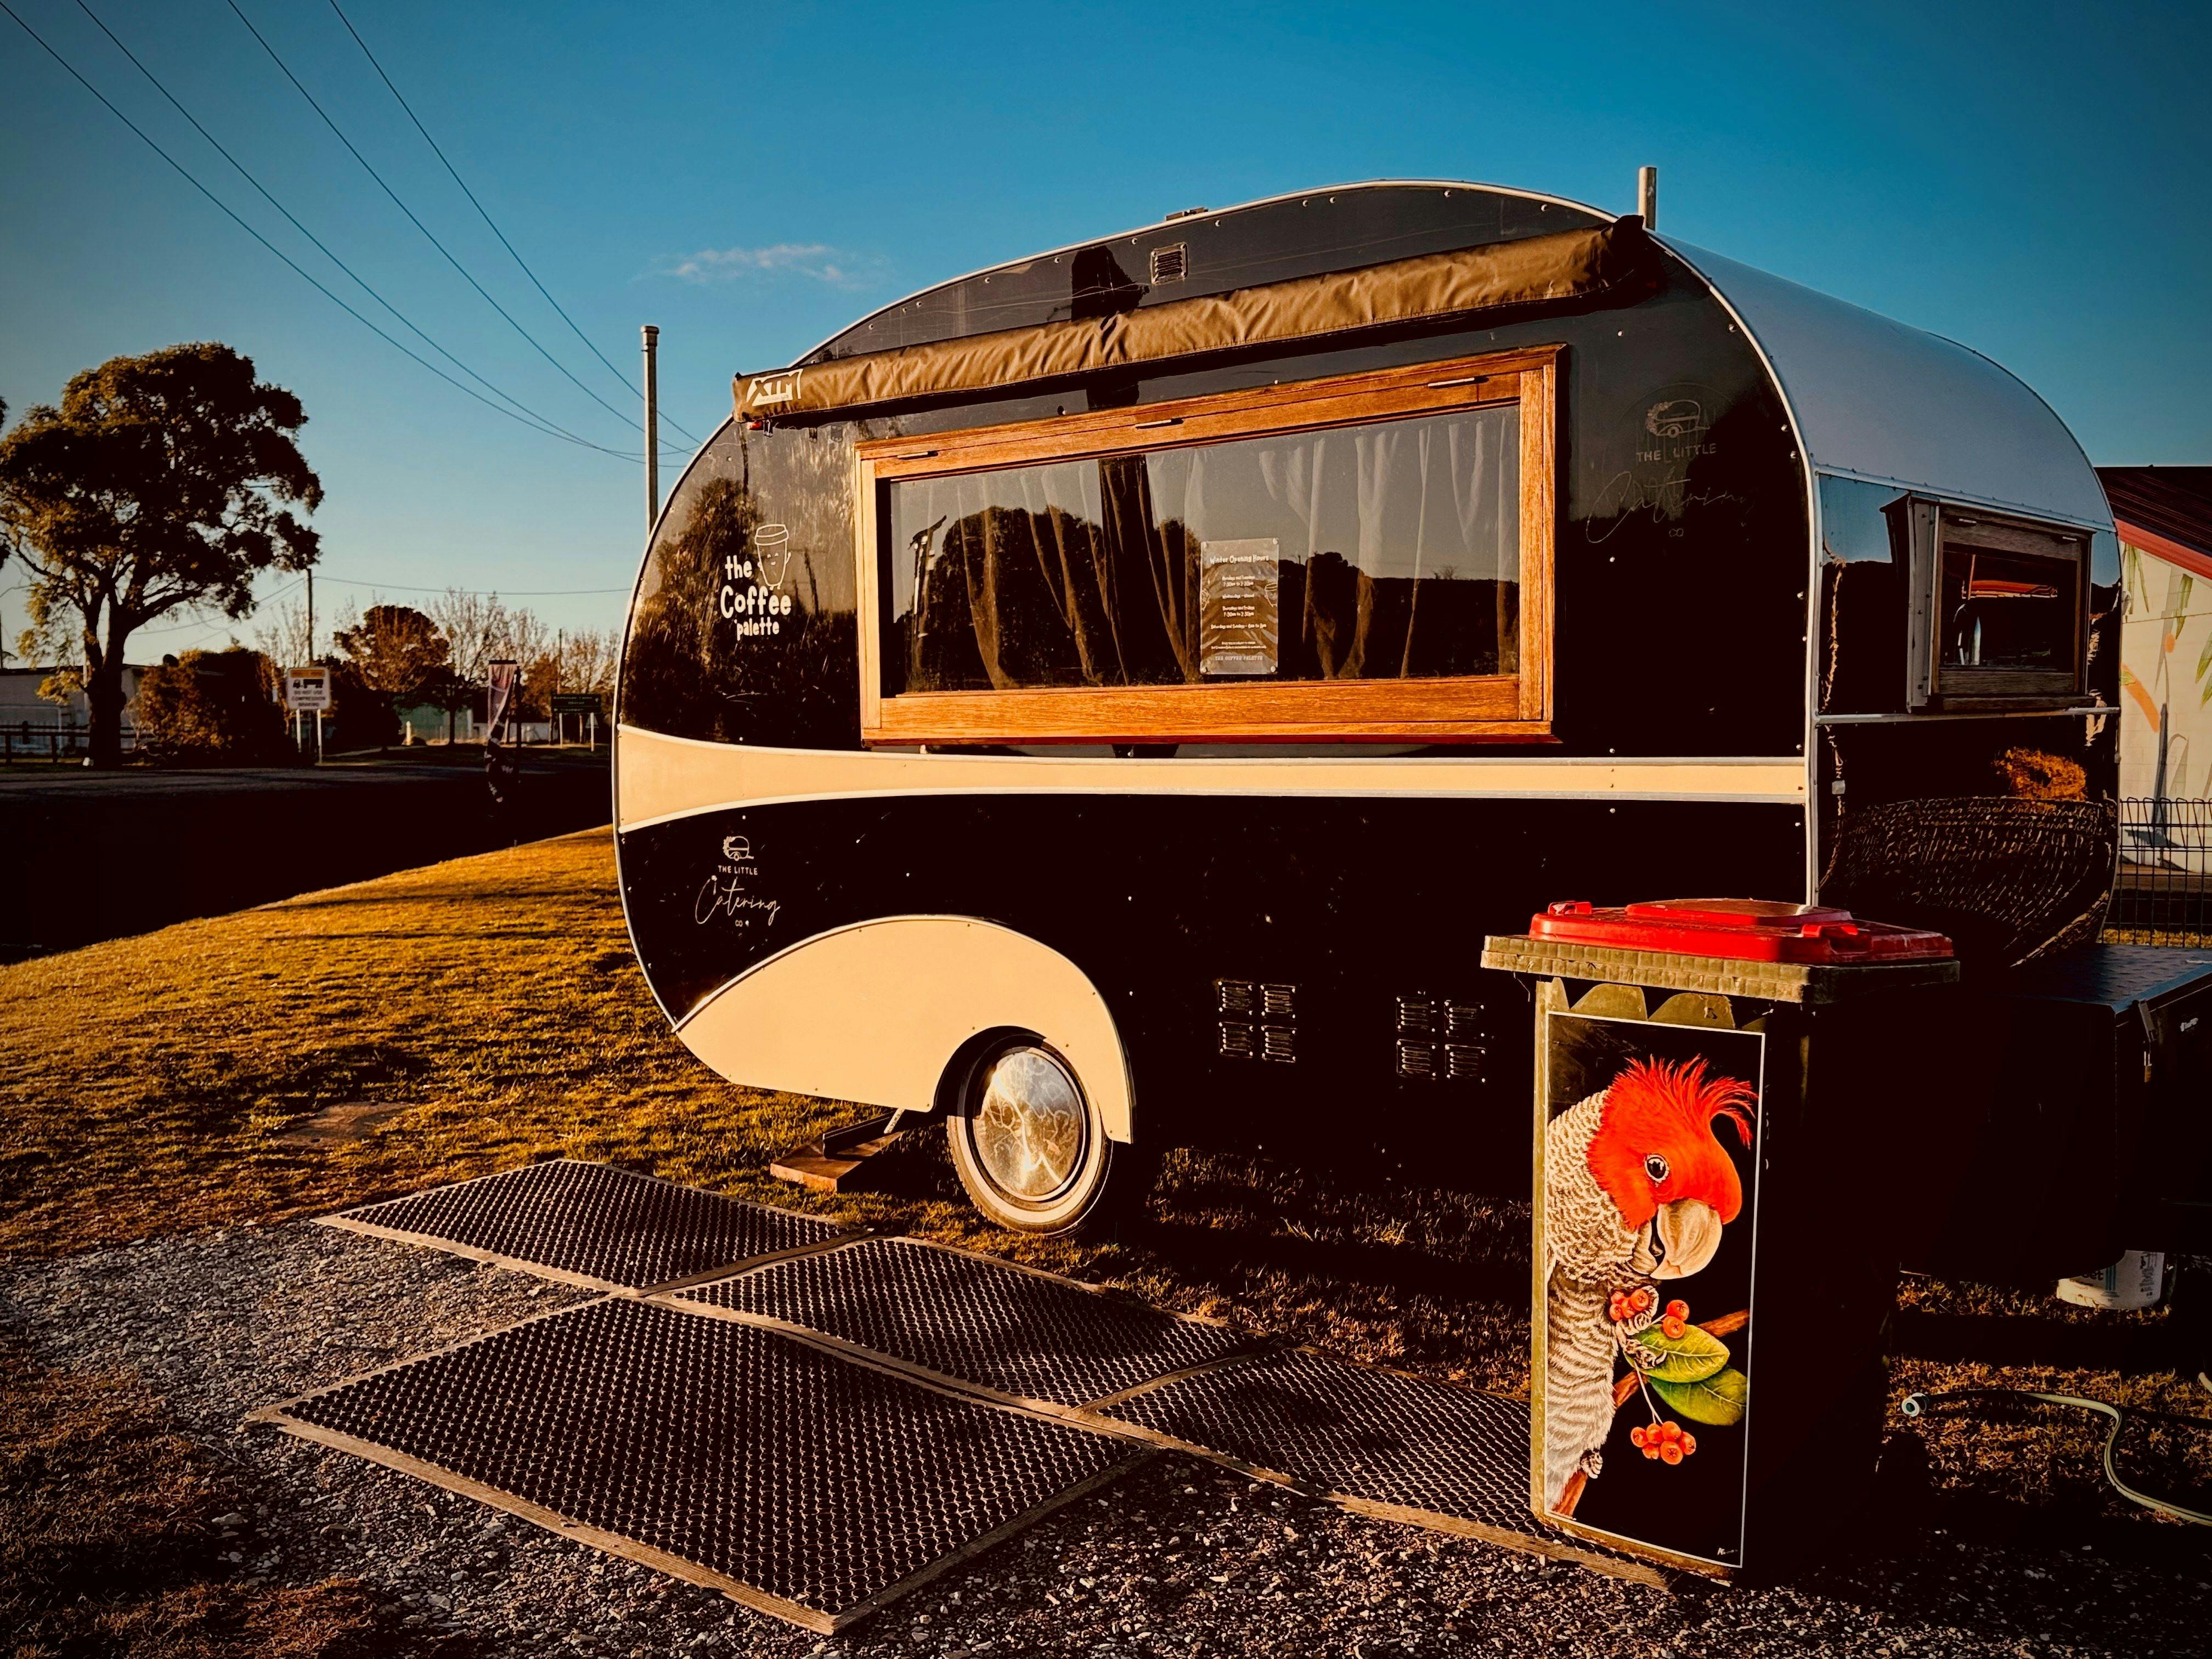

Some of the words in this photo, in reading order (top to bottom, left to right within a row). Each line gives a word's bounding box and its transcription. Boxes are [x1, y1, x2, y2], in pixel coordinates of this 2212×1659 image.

[1635, 450, 1661, 462] THE
[1673, 442, 1717, 459] LITTLE
[724, 554, 752, 580] the
[1210, 555, 1229, 565] Winter
[1229, 555, 1252, 564] Opening
[1252, 554, 1269, 563] Hours
[720, 585, 792, 619] Coffee
[736, 616, 780, 641] palette
[718, 865, 732, 873] THE
[734, 866, 758, 876] LITTLE
[695, 877, 781, 927] Catering
